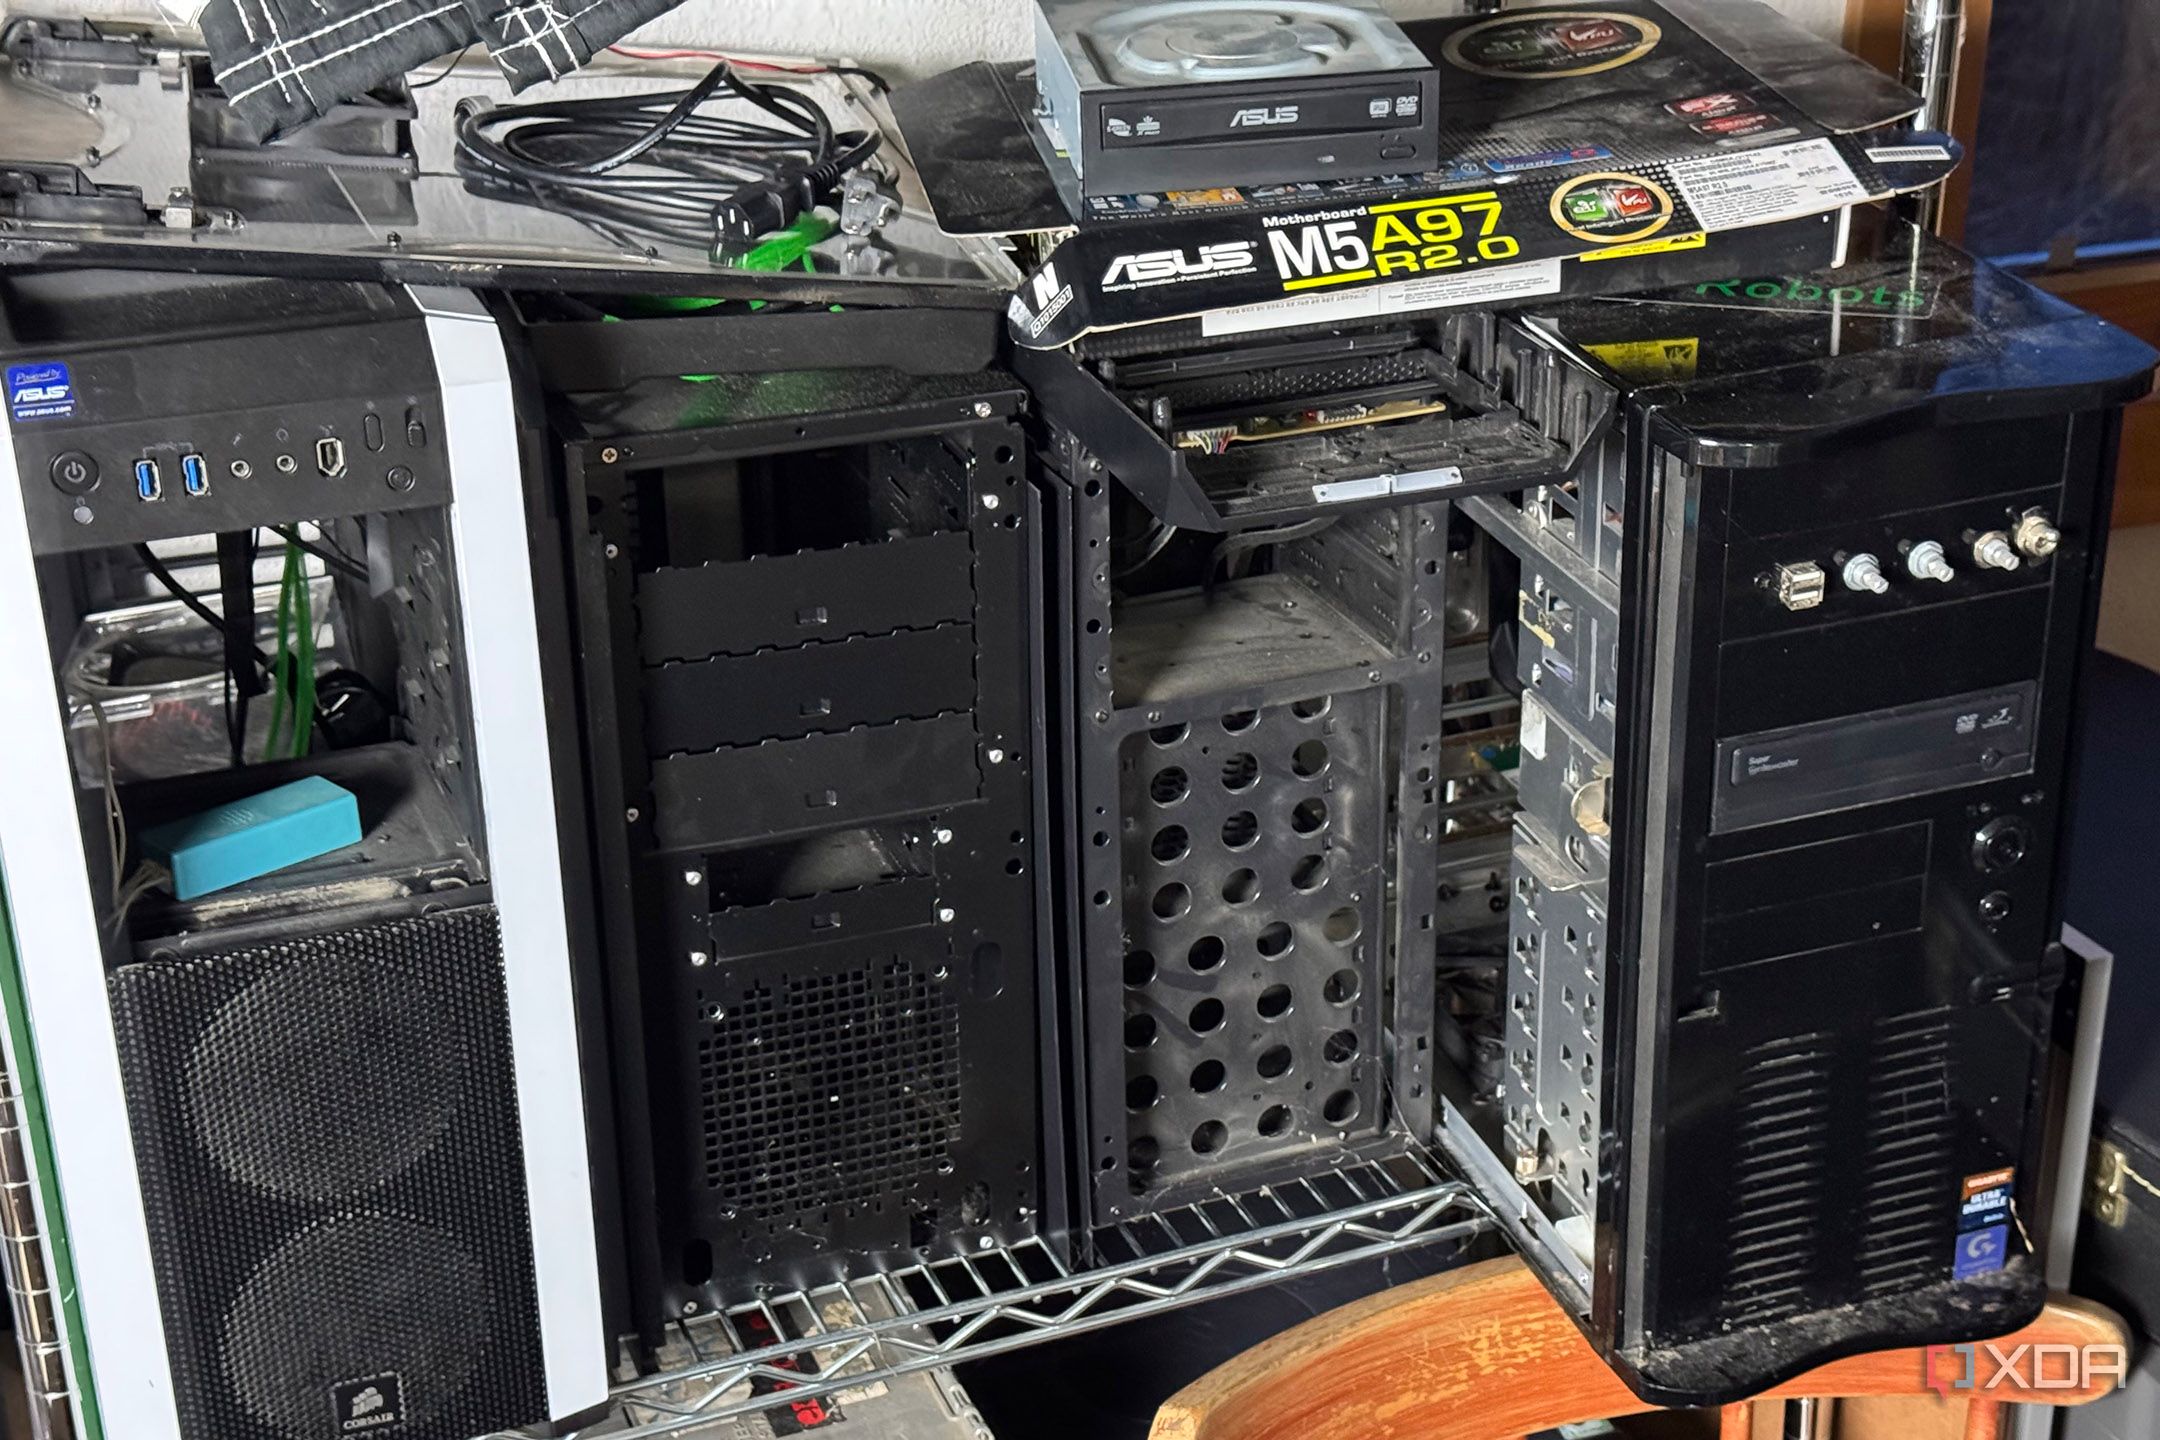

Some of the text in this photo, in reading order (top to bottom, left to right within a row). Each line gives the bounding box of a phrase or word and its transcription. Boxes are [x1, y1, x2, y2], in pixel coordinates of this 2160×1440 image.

[1230, 106, 1298, 128] ASUS
[1262, 206, 1367, 228] Motherboard
[1101, 241, 1254, 286] ASUS
[1374, 236, 1520, 276] R2.0
[1032, 262, 1060, 311] N
[1102, 283, 1136, 293] Inspiring
[1136, 278, 1177, 288] Innovation
[14, 385, 67, 403] ASUS
[17, 405, 72, 418] www.asus.com
[343, 1412, 394, 1430] CORSAIR
